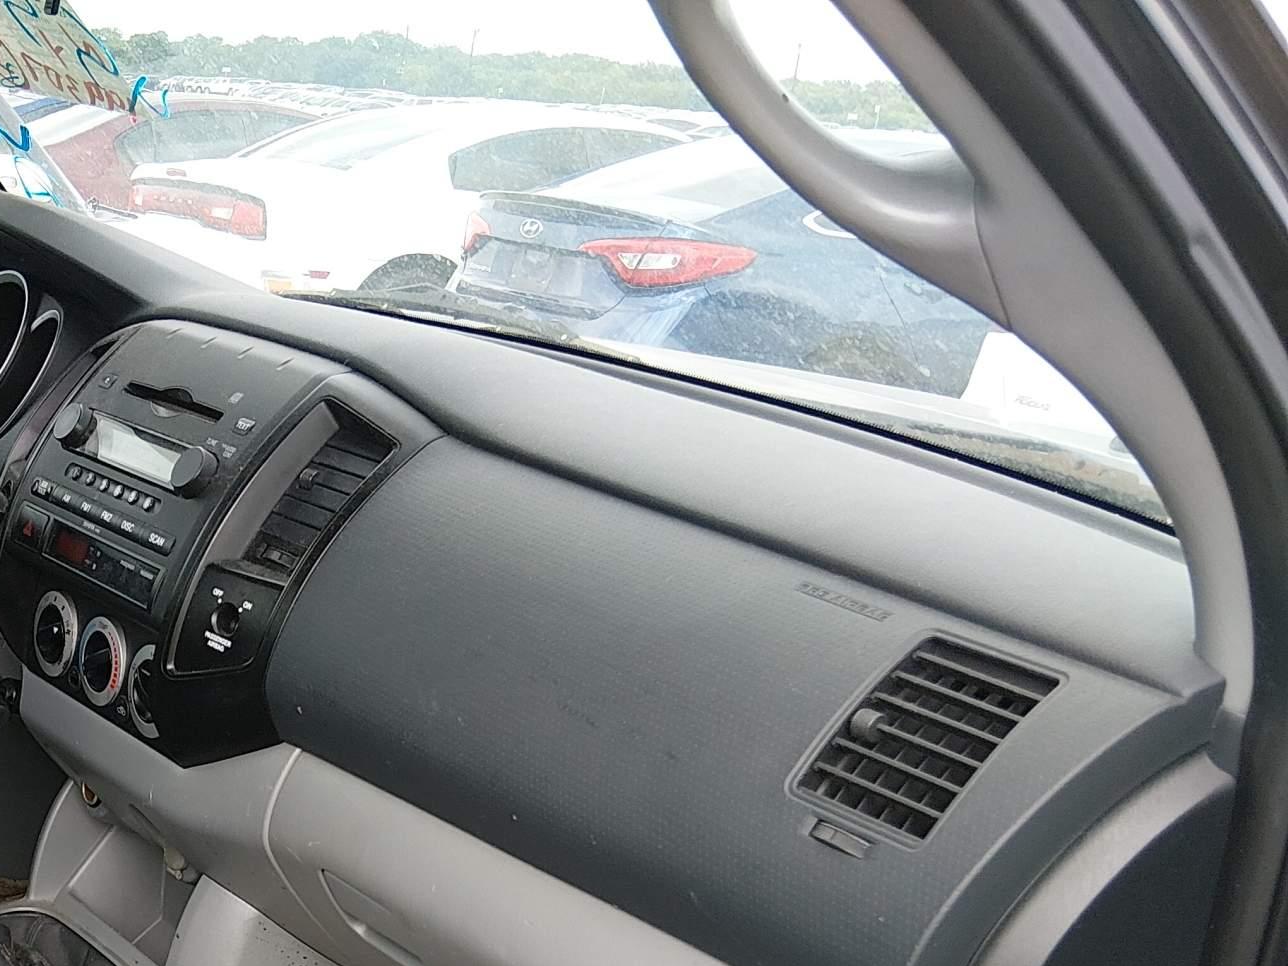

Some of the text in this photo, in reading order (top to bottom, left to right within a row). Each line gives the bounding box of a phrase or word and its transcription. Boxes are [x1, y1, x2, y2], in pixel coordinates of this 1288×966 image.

[120, 519, 135, 533] DISC
[148, 532, 166, 547] SCAN
[212, 587, 224, 597] OFF
[242, 600, 253, 610] ON
